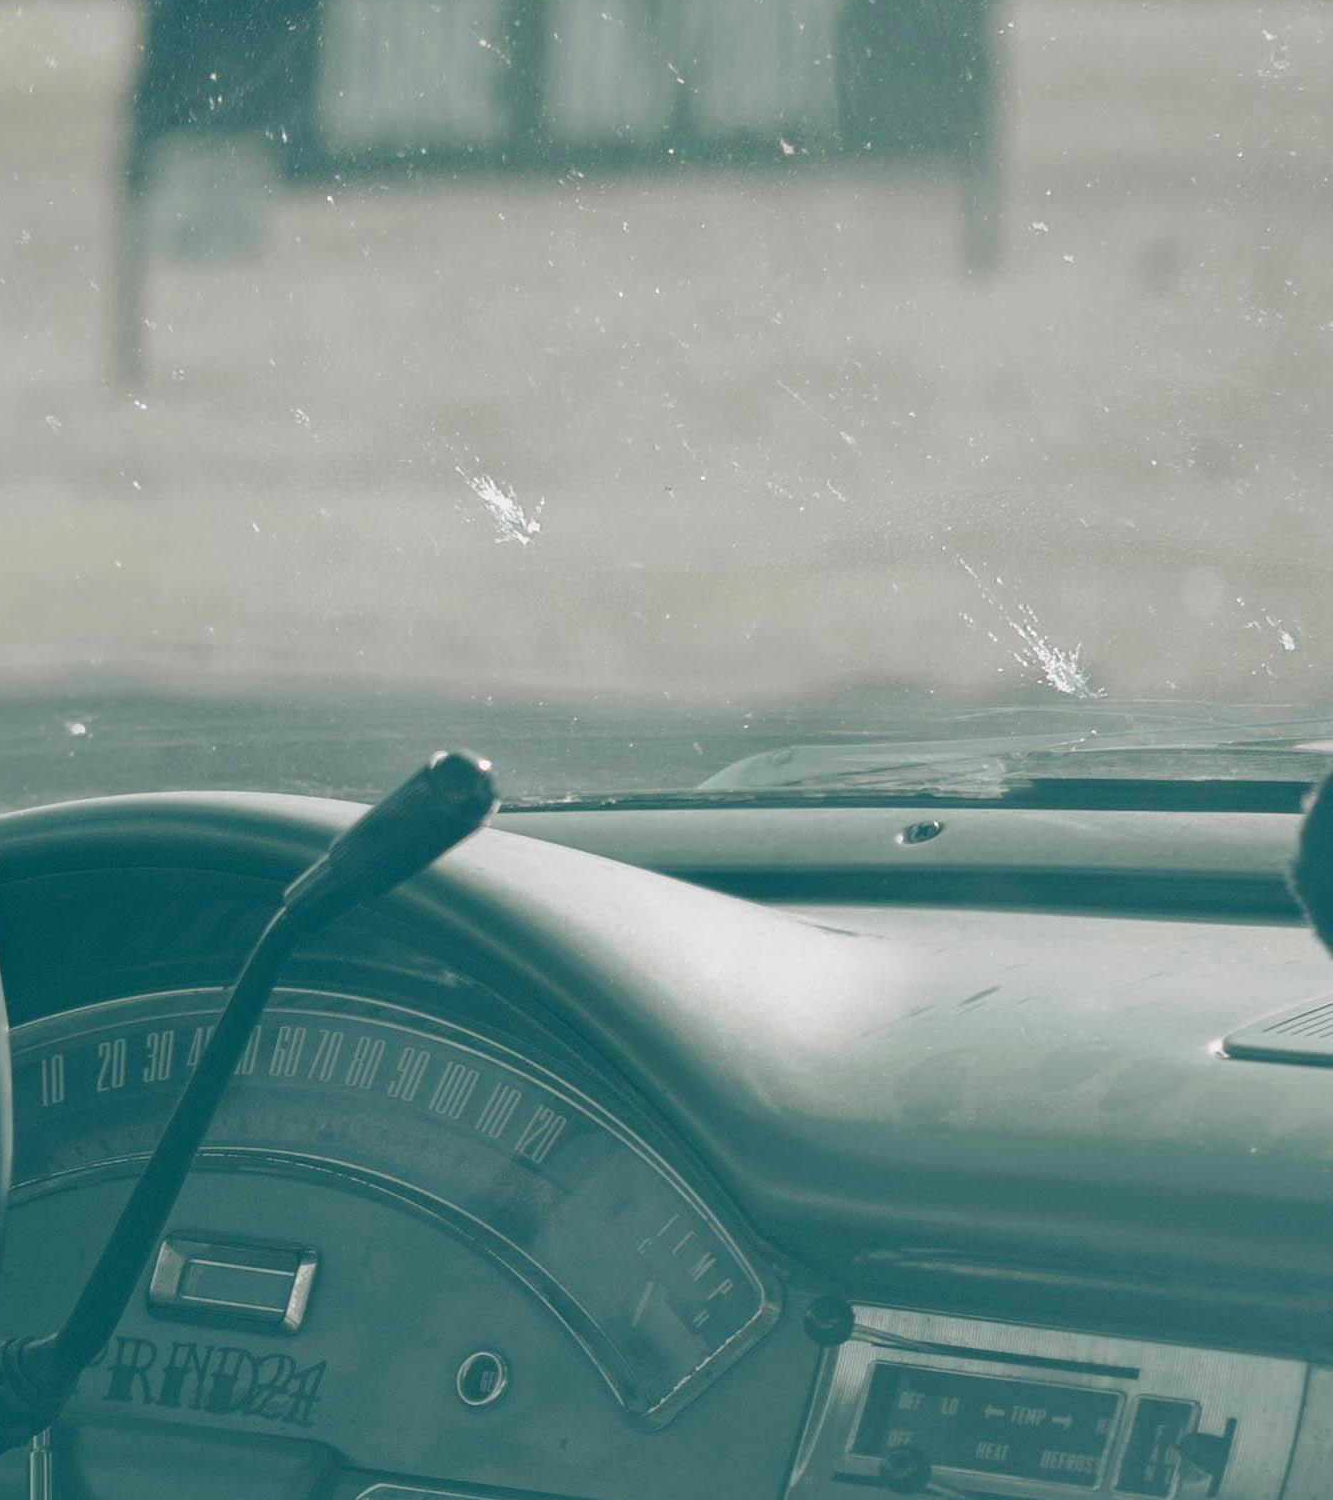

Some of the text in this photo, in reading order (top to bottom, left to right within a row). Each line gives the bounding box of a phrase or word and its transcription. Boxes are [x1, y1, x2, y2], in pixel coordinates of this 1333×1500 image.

[41, 1054, 65, 1107] 10
[96, 1038, 127, 1092] 20
[143, 1030, 174, 1083] 30
[234, 1025, 262, 1076] 0
[269, 1026, 307, 1078] 60
[307, 1029, 344, 1083] 70
[344, 1036, 386, 1090] 80
[387, 1047, 431, 1102] 90
[429, 1061, 481, 1120] 100
[474, 1082, 522, 1139] 110
[514, 1103, 567, 1165] 120
[656, 1212, 734, 1301] TEMP
[941, 1397, 960, 1416] LO
[1010, 1405, 1048, 1426] TEMP
[975, 1441, 1010, 1462] HEAT
